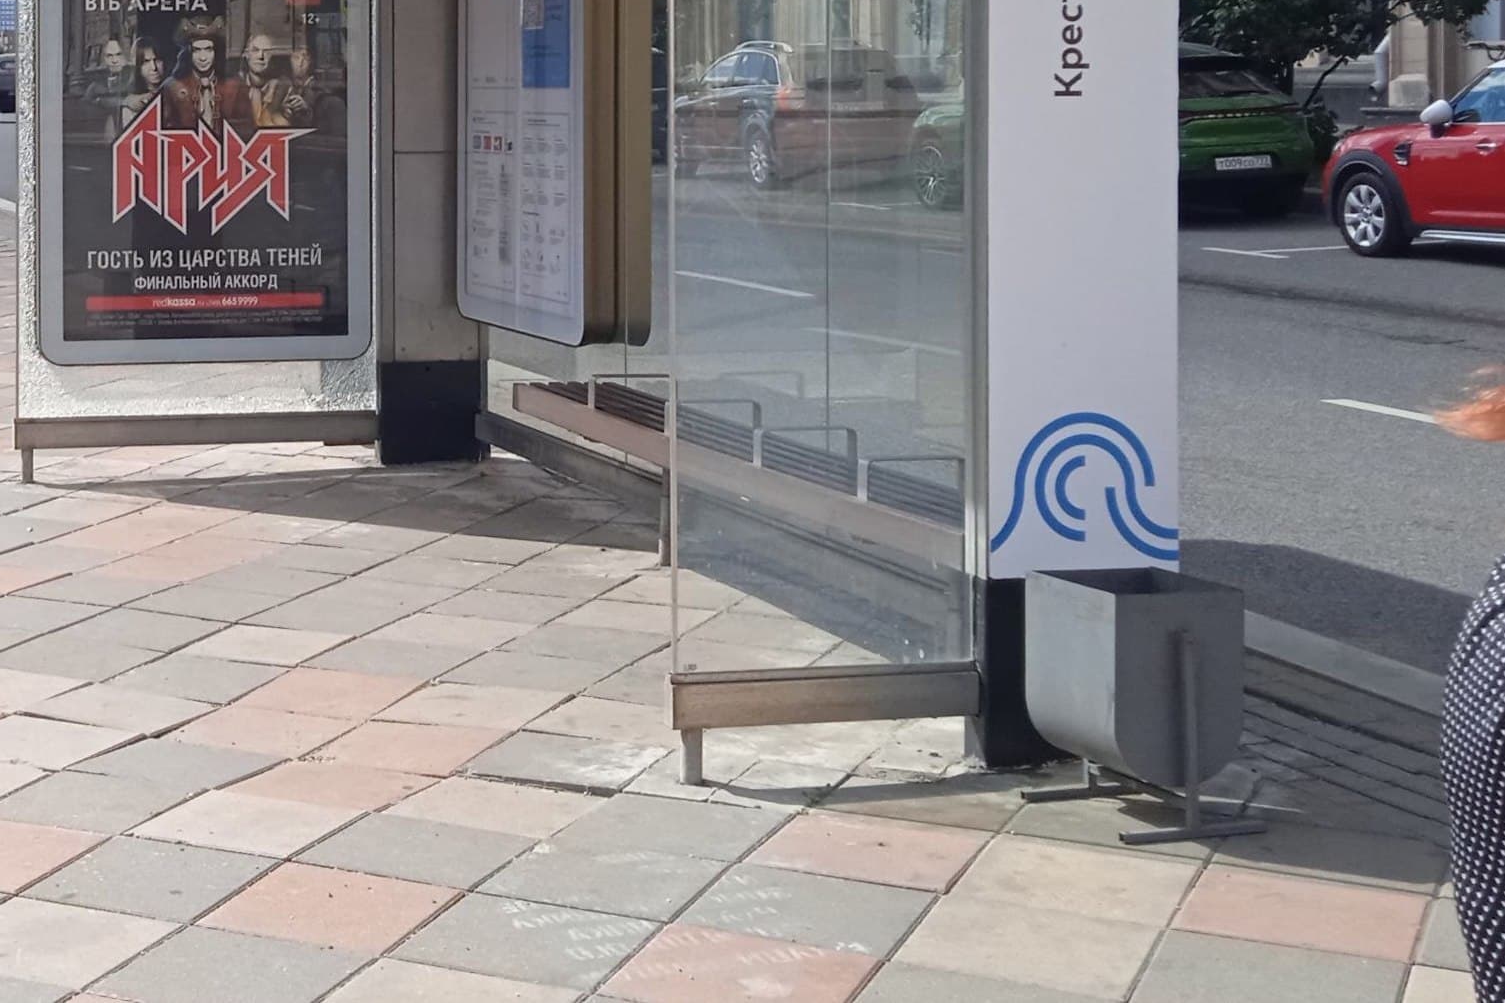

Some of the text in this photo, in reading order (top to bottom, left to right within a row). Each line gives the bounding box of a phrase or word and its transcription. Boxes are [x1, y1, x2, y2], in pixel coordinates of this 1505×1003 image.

[301, 12, 320, 25] 12+
[112, 93, 319, 236] АРИЯ
[87, 243, 323, 271] ГОСТЬ ИЗ ЦАРСТВА ТЕНЕЙ
[134, 272, 278, 290] ФИНАЛЬНЫЙ АККОРД
